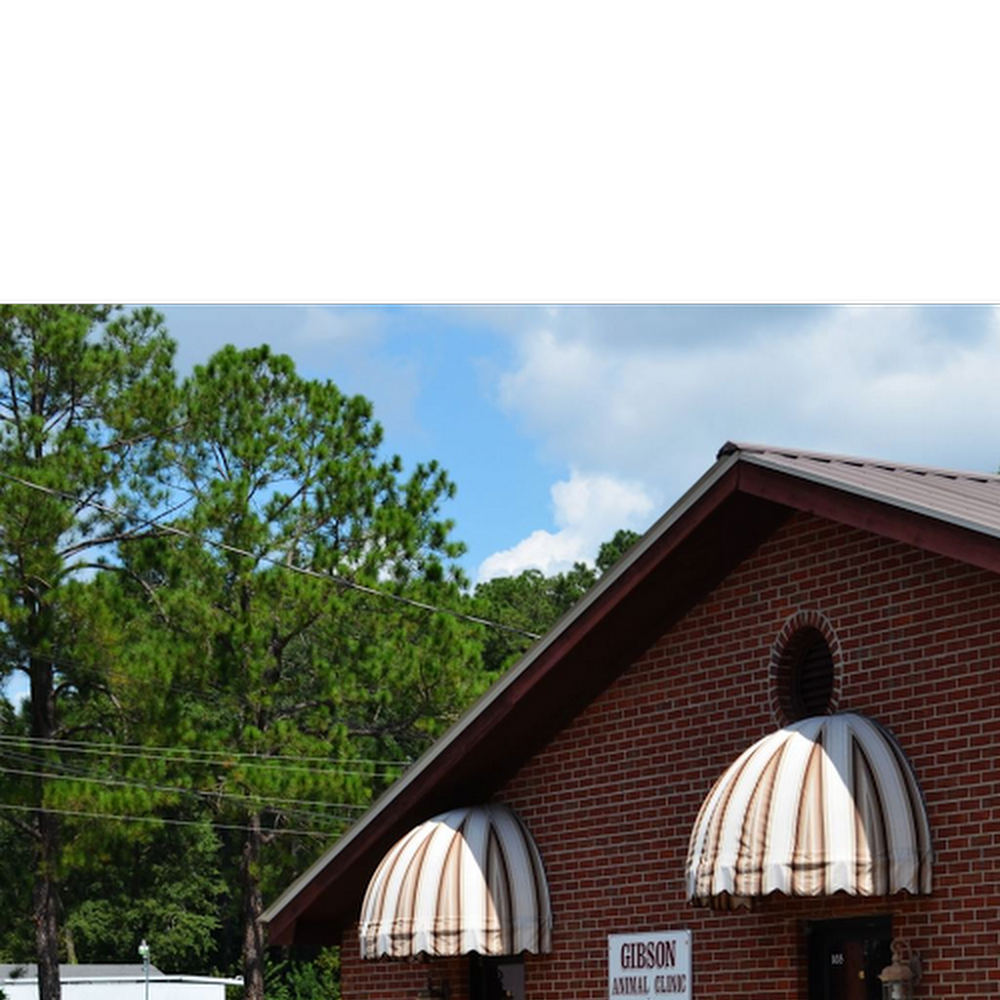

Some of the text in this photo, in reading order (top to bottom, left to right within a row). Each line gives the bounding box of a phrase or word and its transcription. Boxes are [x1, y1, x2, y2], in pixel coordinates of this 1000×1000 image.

[621, 940, 676, 968] GIBSON
[612, 974, 687, 995] ANIMAL CLINIC
